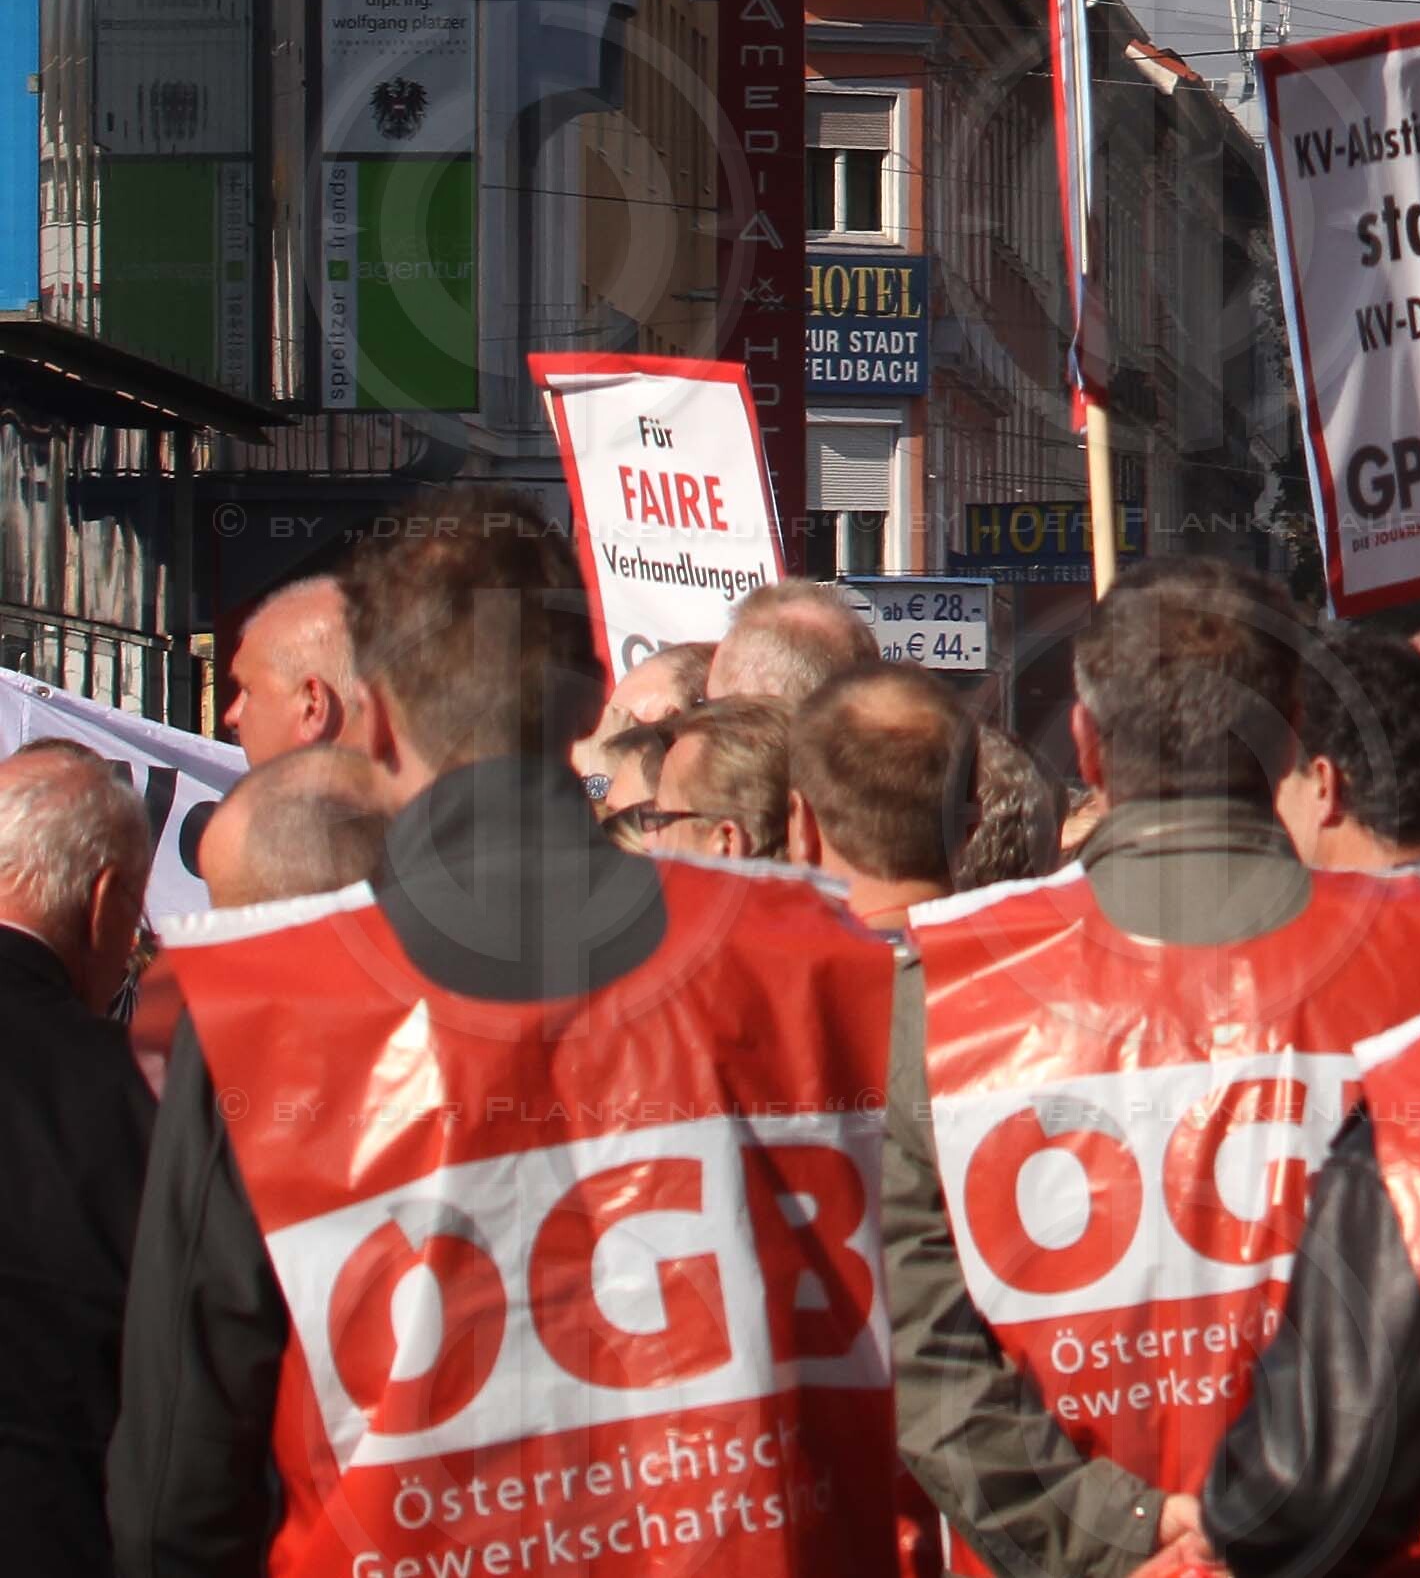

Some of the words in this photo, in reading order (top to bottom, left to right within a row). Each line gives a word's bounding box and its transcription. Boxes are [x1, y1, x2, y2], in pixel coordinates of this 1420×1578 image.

[332, 14, 407, 33] wolfgang
[412, 14, 466, 31] platzer
[328, 292, 349, 400] spreitzer
[849, 330, 919, 354] STADT
[638, 415, 673, 449] Für
[618, 465, 728, 531] FAIRE
[972, 505, 1137, 554] HOTL
[883, 603, 903, 622] ab
[907, 593, 926, 622] €
[883, 641, 902, 661] ab
[906, 632, 926, 662] €
